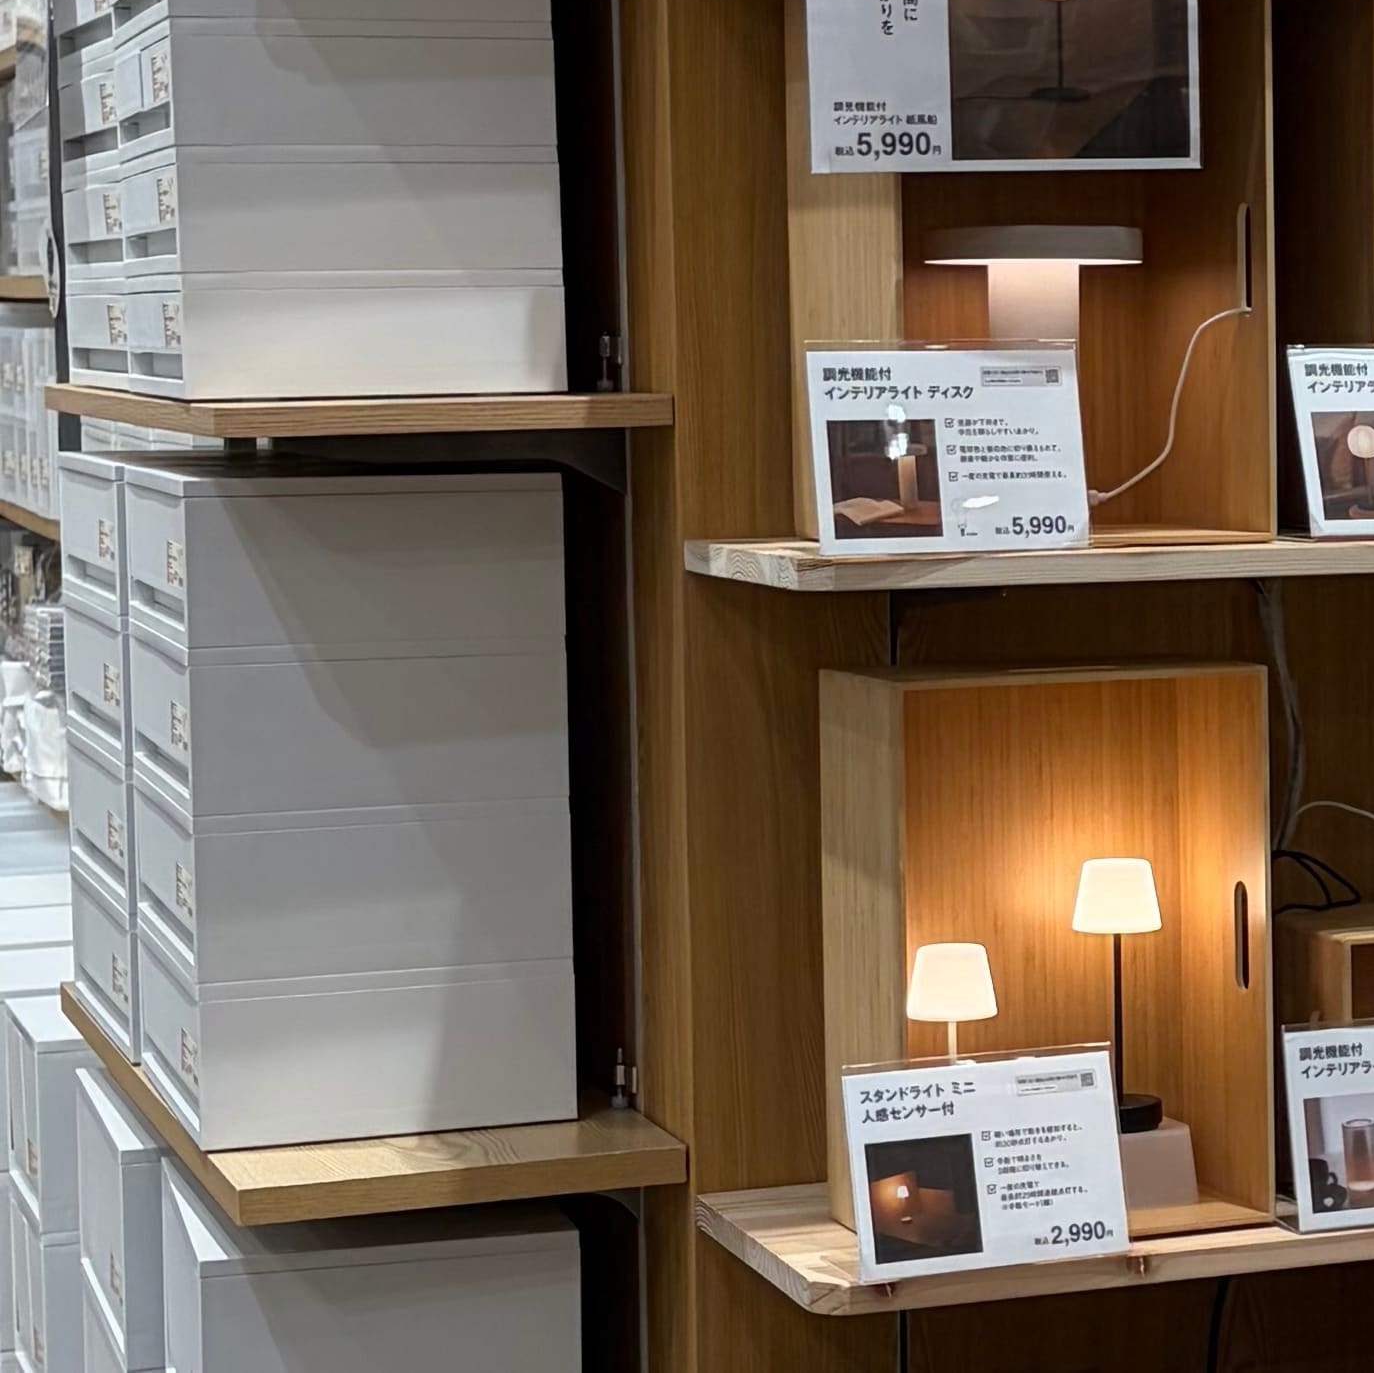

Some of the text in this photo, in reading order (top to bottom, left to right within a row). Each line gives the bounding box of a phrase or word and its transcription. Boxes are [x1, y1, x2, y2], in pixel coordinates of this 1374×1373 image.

[833, 114, 903, 126] インテリアライト
[823, 367, 892, 382] 調光機能付
[1304, 363, 1368, 377] 調光機能付
[824, 384, 974, 400] インテリアライト ディスク
[1299, 1042, 1363, 1061] 調光機能付
[859, 1081, 976, 1105] スタンドライト ミニ
[862, 1100, 955, 1124] 人感センサー付
